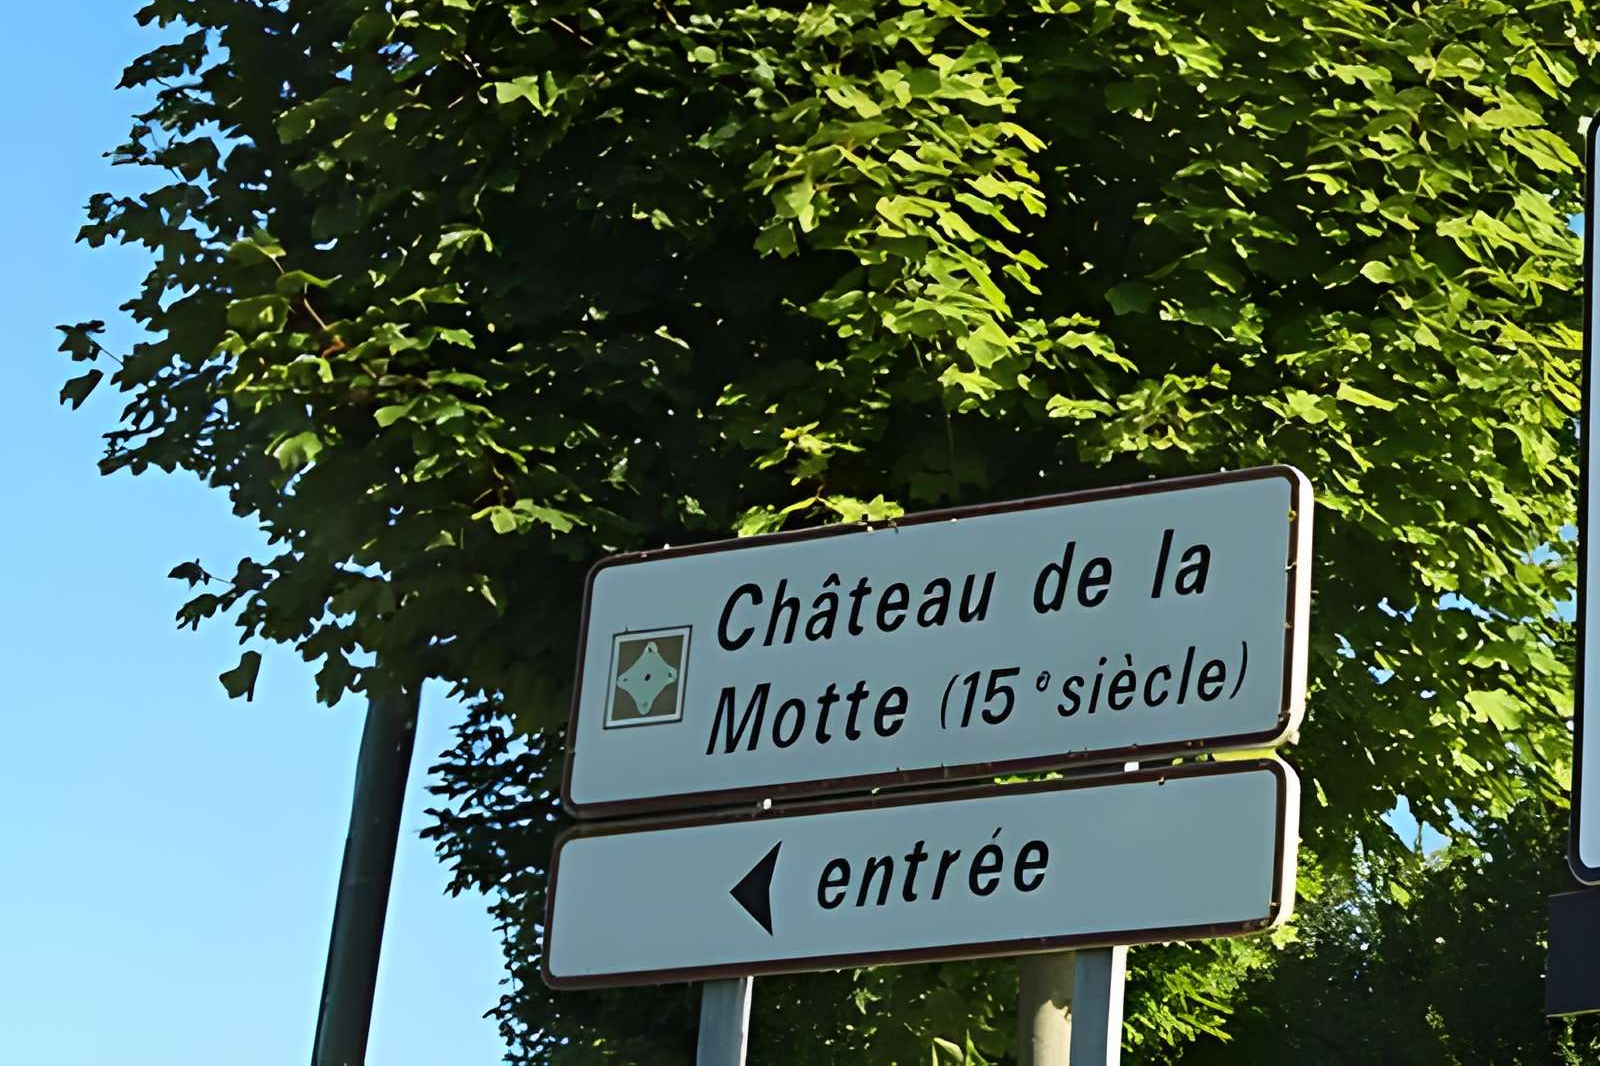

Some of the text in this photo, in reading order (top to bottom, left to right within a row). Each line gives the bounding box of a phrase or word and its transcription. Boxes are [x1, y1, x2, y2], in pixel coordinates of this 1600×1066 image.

[717, 528, 1211, 652] Château de la
[705, 680, 909, 756] Motte
[817, 826, 1050, 910] entrée
